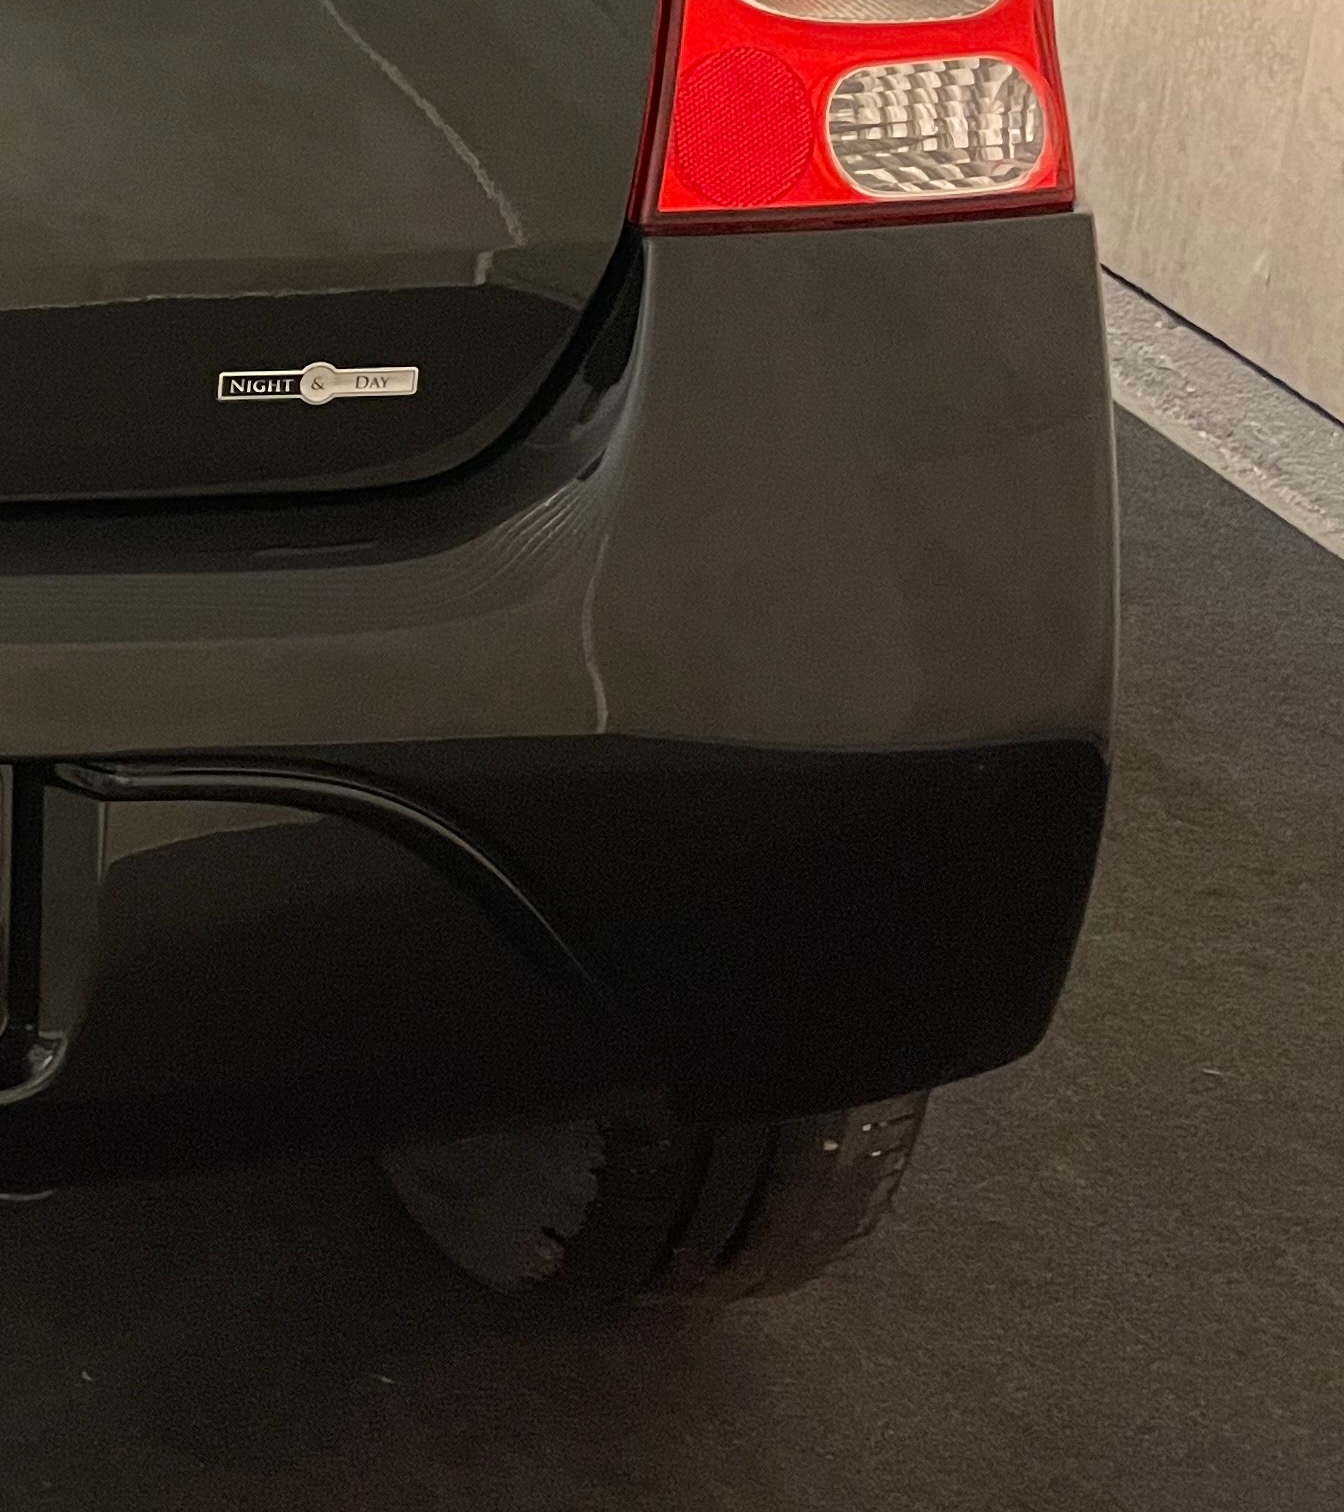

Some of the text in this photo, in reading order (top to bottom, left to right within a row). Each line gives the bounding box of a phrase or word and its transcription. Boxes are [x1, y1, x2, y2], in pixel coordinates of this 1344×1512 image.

[229, 374, 391, 394] NIGHT & DAY
